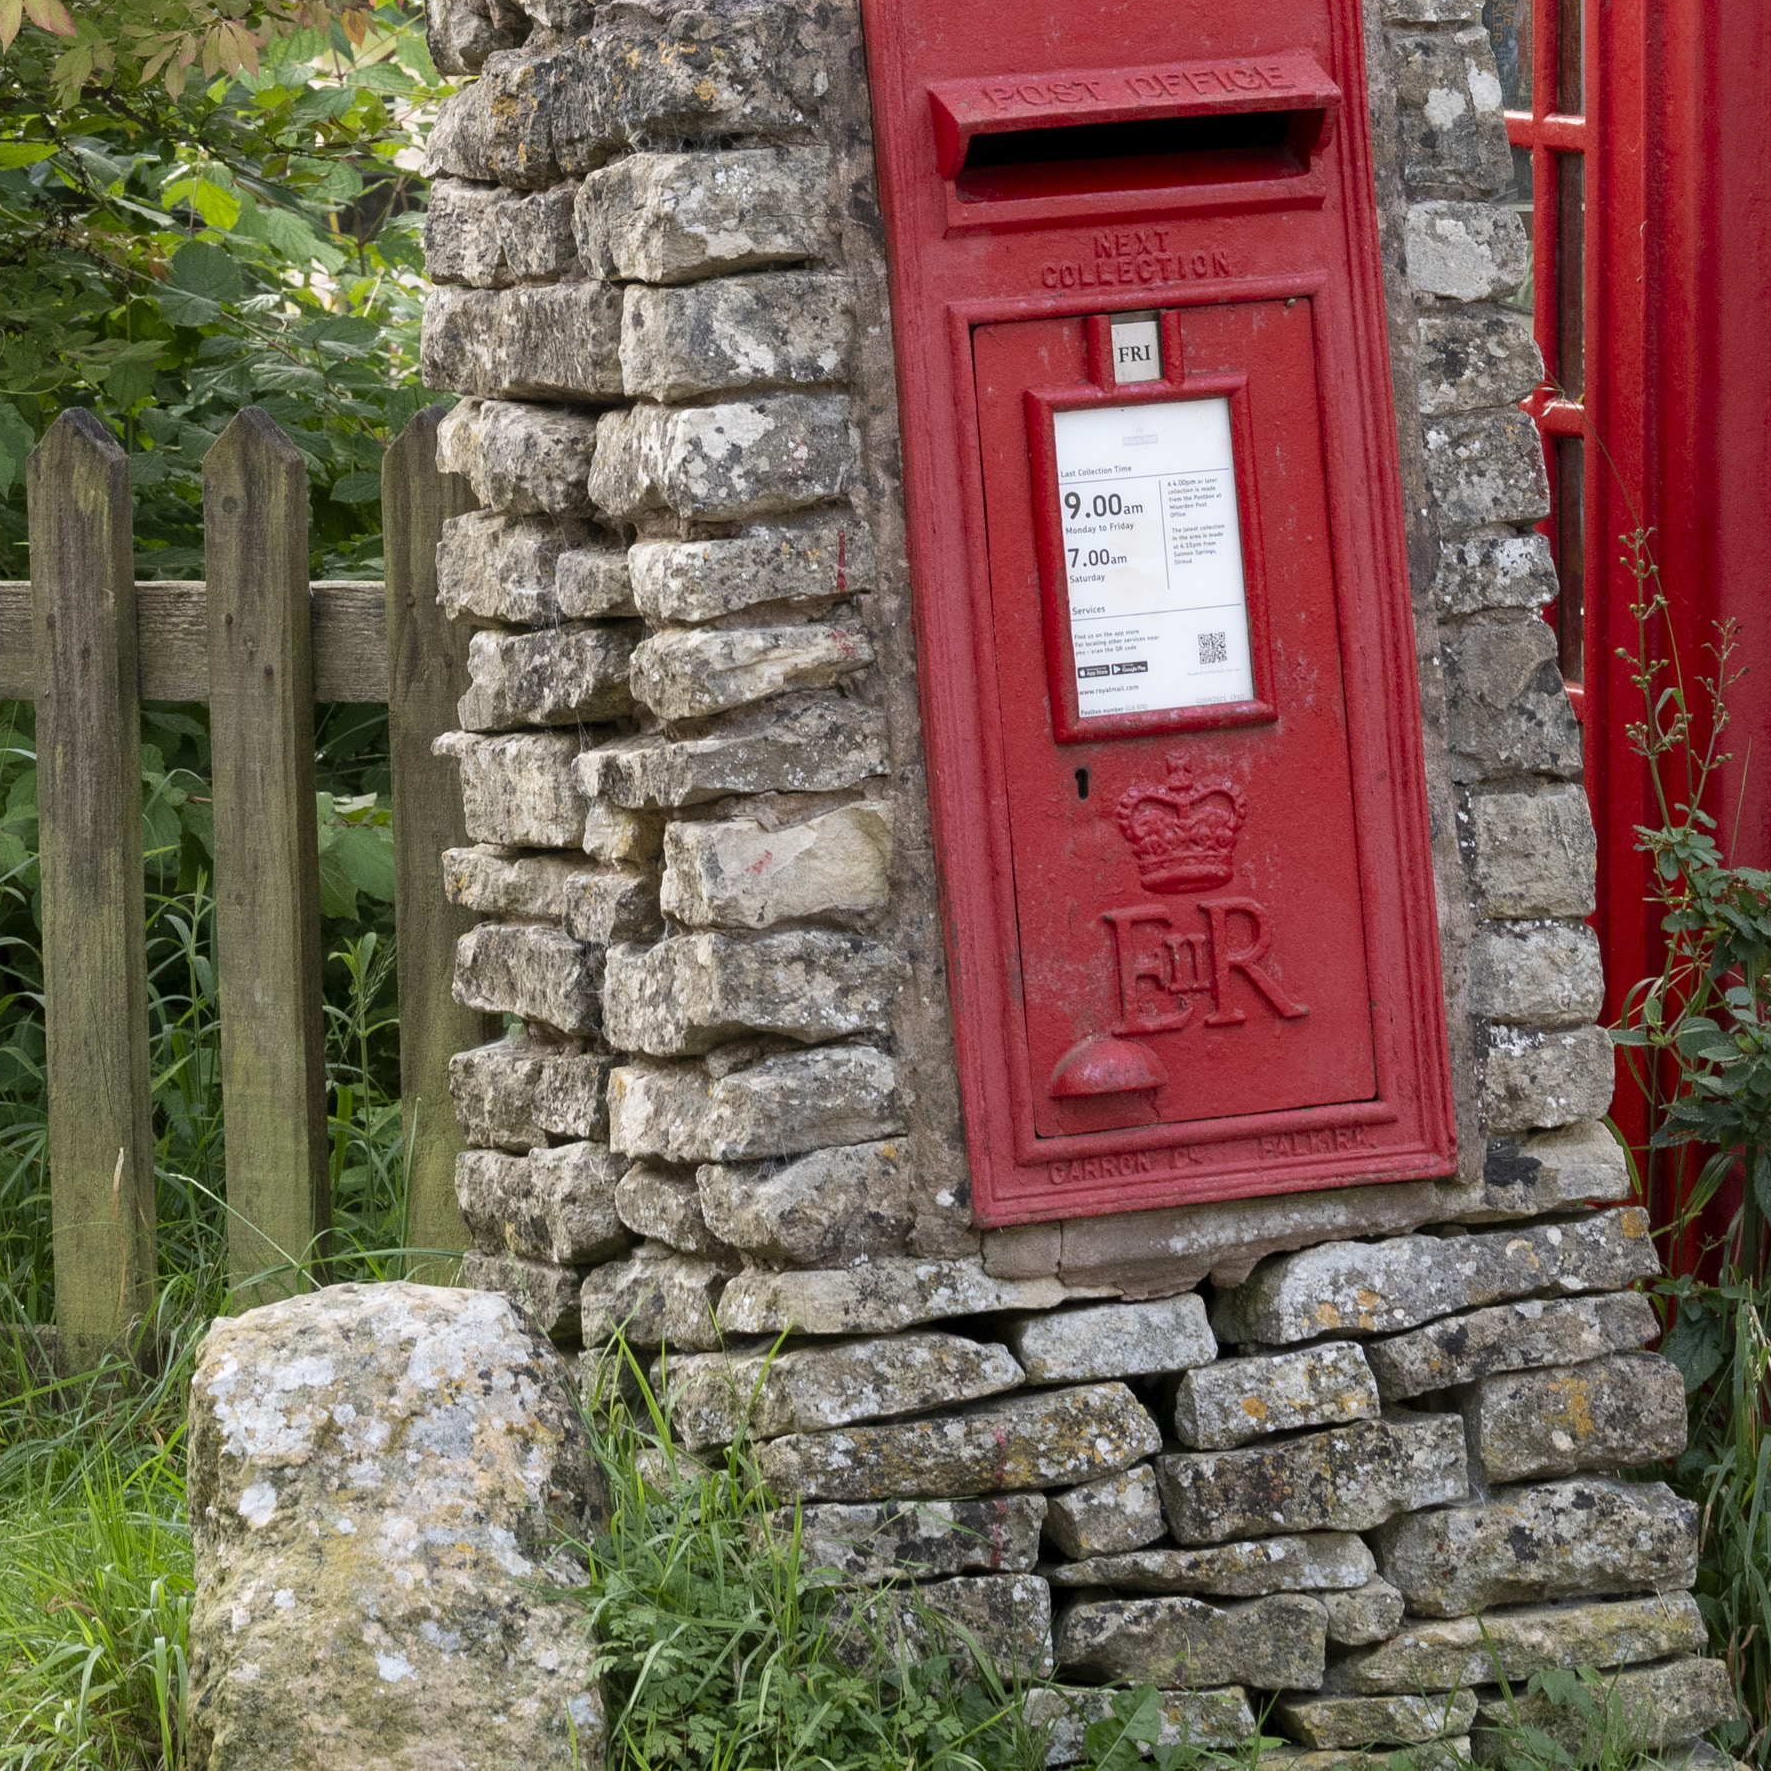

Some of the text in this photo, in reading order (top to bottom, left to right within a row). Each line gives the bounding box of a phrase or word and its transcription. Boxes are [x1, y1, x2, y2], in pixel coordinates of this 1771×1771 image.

[983, 66, 1296, 110] POST OFFICE
[1093, 230, 1170, 259] NEXT
[1041, 250, 1231, 290] COLLECTION
[1118, 345, 1151, 363] FRI
[1061, 465, 1131, 478] Last Collection Time
[1064, 491, 1143, 520] 9.00am
[1066, 527, 1096, 535] Monday
[1110, 522, 1134, 531] Friday
[1068, 548, 1127, 568] 7.00am
[1070, 574, 1105, 583] Saturday
[1072, 606, 1105, 615] Services
[1079, 684, 1139, 696] www.royalmail.com
[1081, 706, 1123, 716] Postbox number
[1049, 1152, 1151, 1185] CARRON
